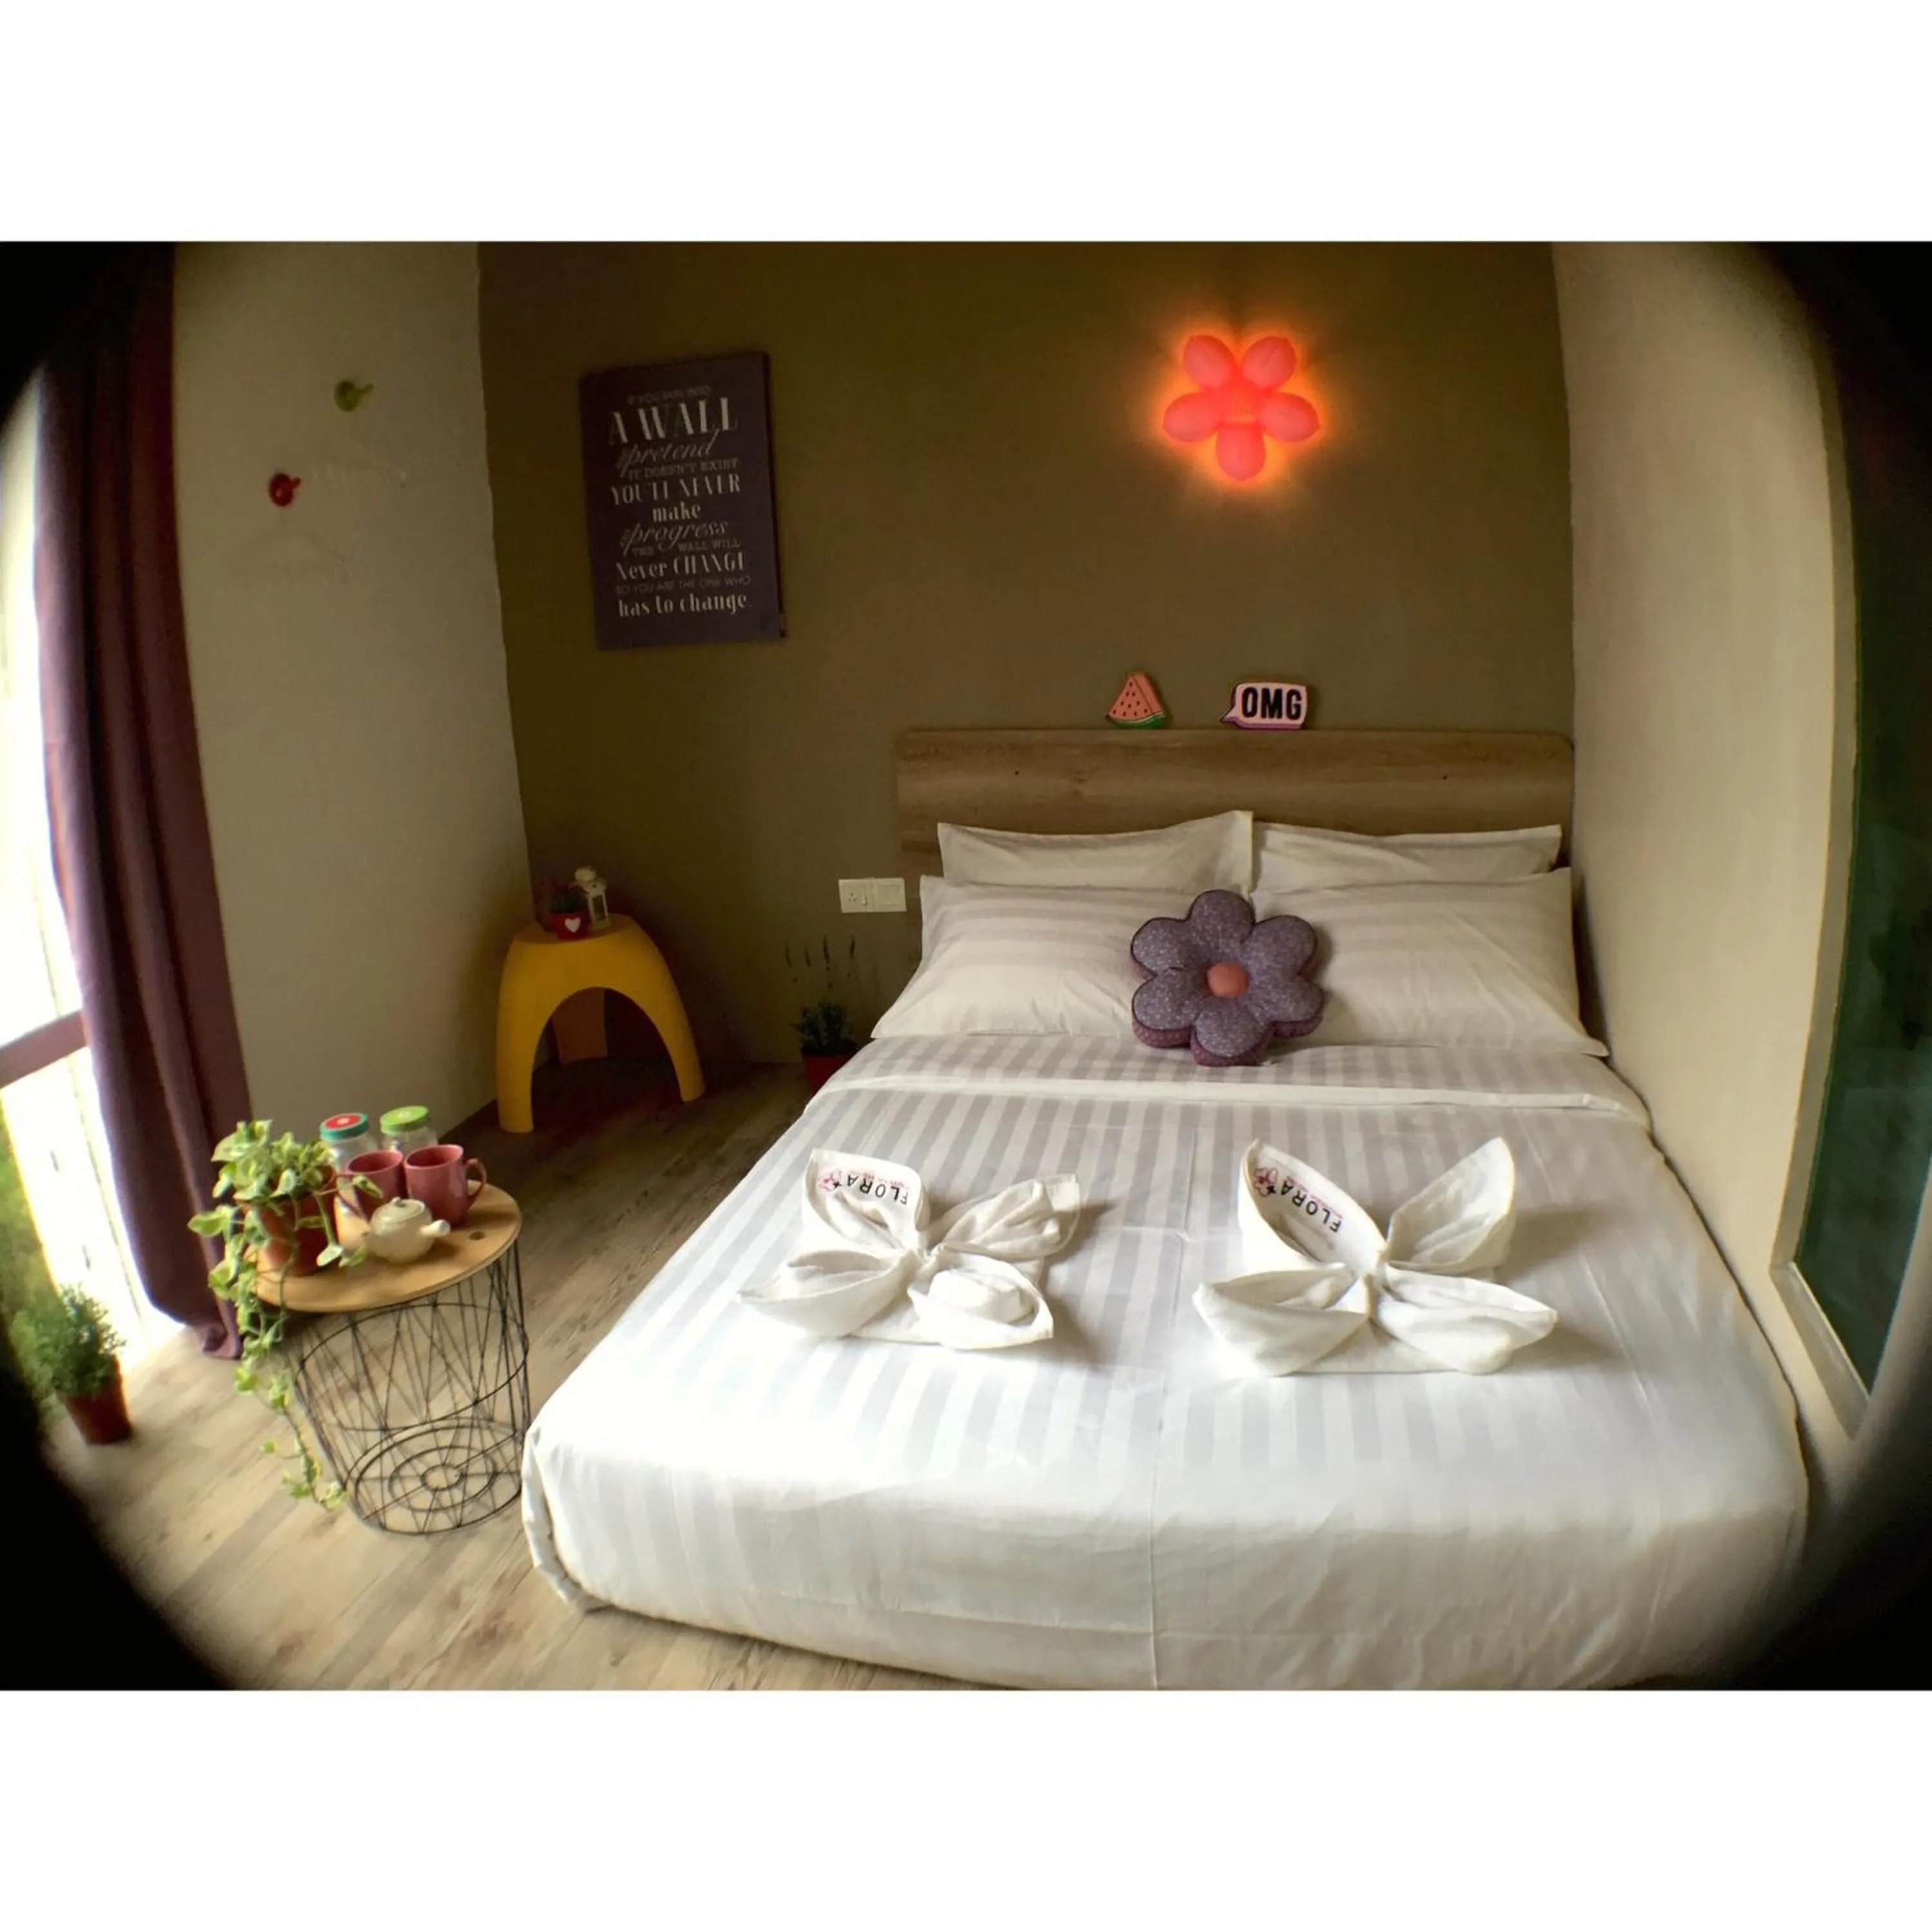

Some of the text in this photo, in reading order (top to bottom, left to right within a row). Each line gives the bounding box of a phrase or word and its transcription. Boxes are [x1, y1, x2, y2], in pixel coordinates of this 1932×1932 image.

[609, 397, 739, 446] A WALL
[616, 428, 721, 478] pretend
[679, 473, 741, 498] NEVER
[652, 500, 701, 522] make
[619, 520, 728, 557] progress
[616, 561, 668, 582] Never
[673, 551, 745, 575] CHANGE
[618, 598, 650, 618] has
[655, 594, 674, 614] to
[1242, 687, 1302, 720] OMG
[847, 1174, 909, 1205] FLORA
[1281, 1179, 1342, 1233] FLORA
